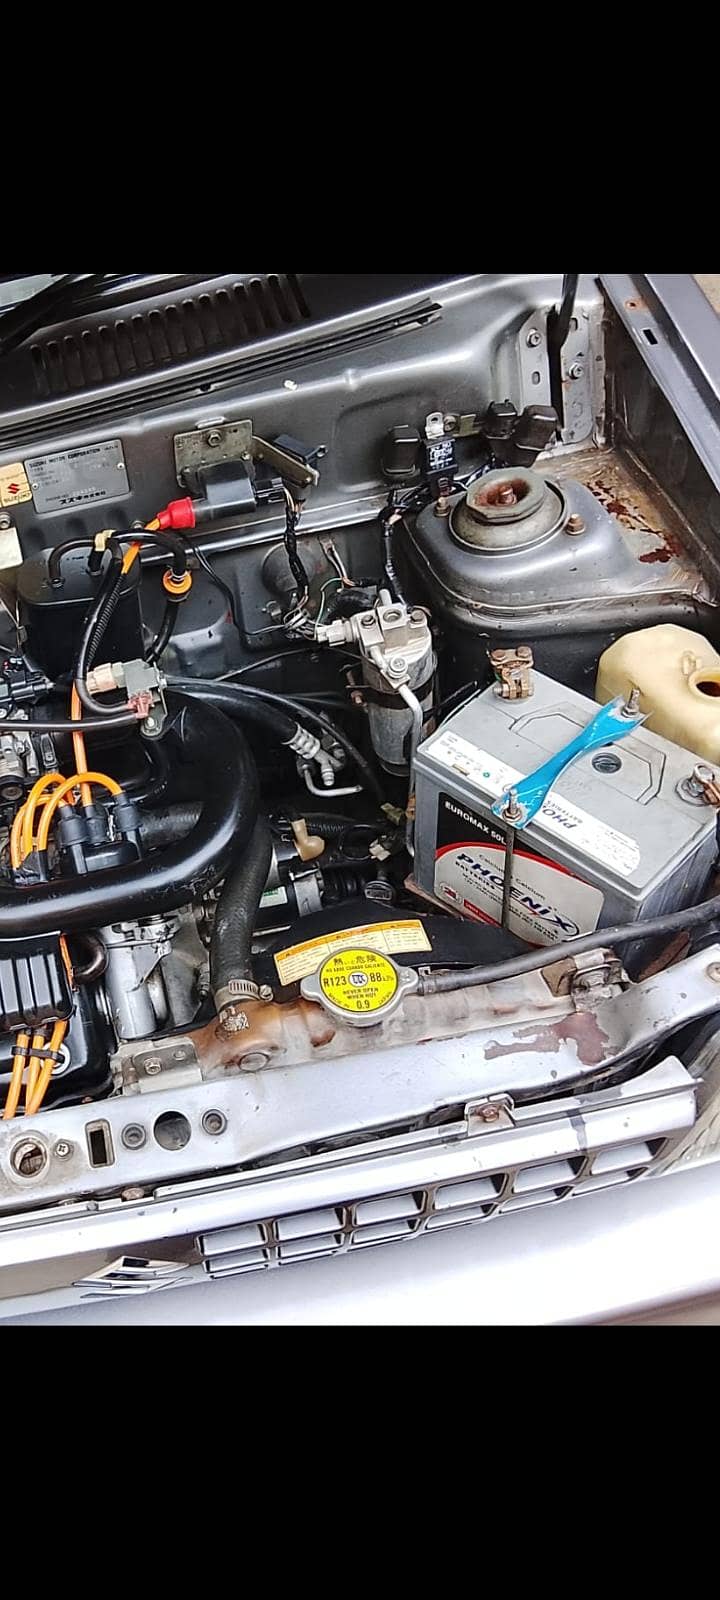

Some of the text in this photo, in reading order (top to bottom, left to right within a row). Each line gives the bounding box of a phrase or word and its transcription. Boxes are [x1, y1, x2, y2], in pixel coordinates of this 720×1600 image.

[67, 447, 101, 459] CORPORATION
[444, 800, 490, 834] EUROMAX
[541, 805, 578, 830] PHO
[514, 878, 547, 901] Calcium
[322, 975, 347, 988] R123
[369, 972, 382, 983] 88
[356, 1000, 370, 1009] 0.9
